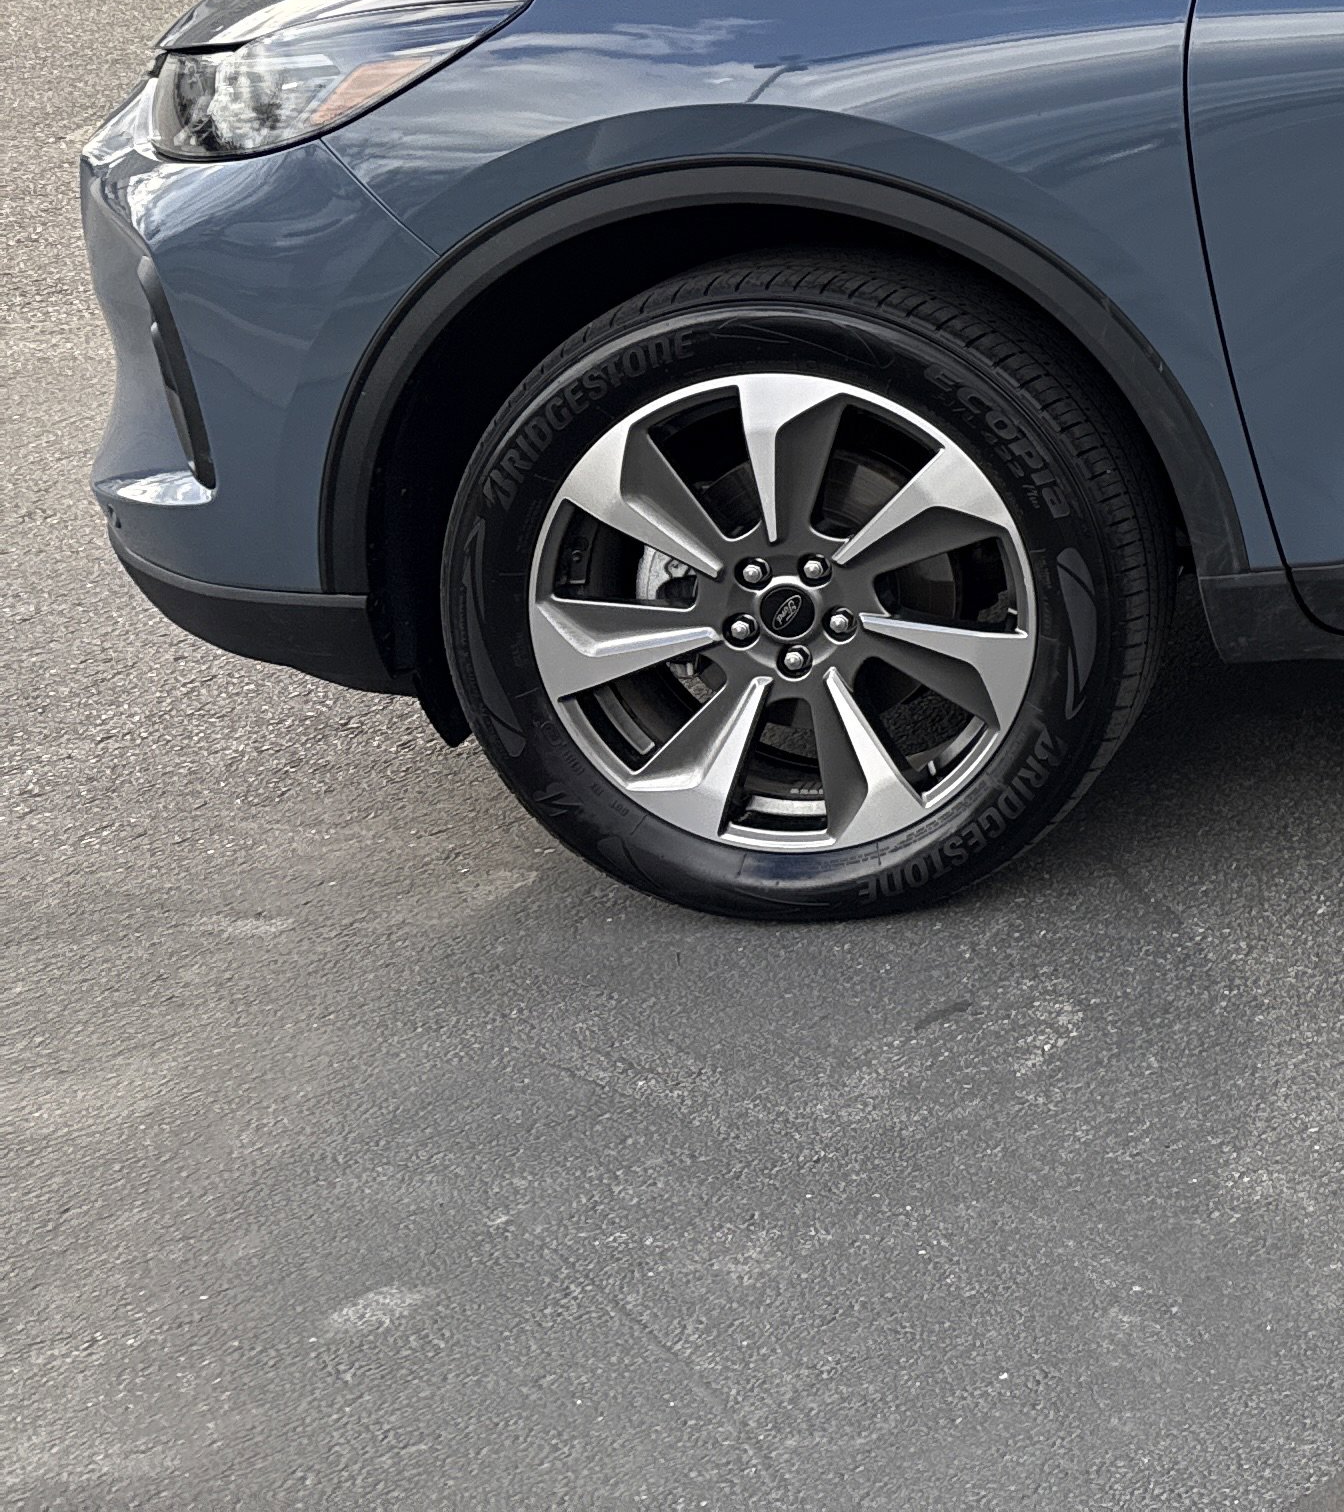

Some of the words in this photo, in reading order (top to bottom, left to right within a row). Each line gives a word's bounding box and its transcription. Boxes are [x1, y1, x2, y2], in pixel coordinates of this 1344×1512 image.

[482, 329, 695, 512] BRIDGESTONE
[775, 599, 798, 626] Ford
[855, 722, 1067, 906] BRIDGESTONE
